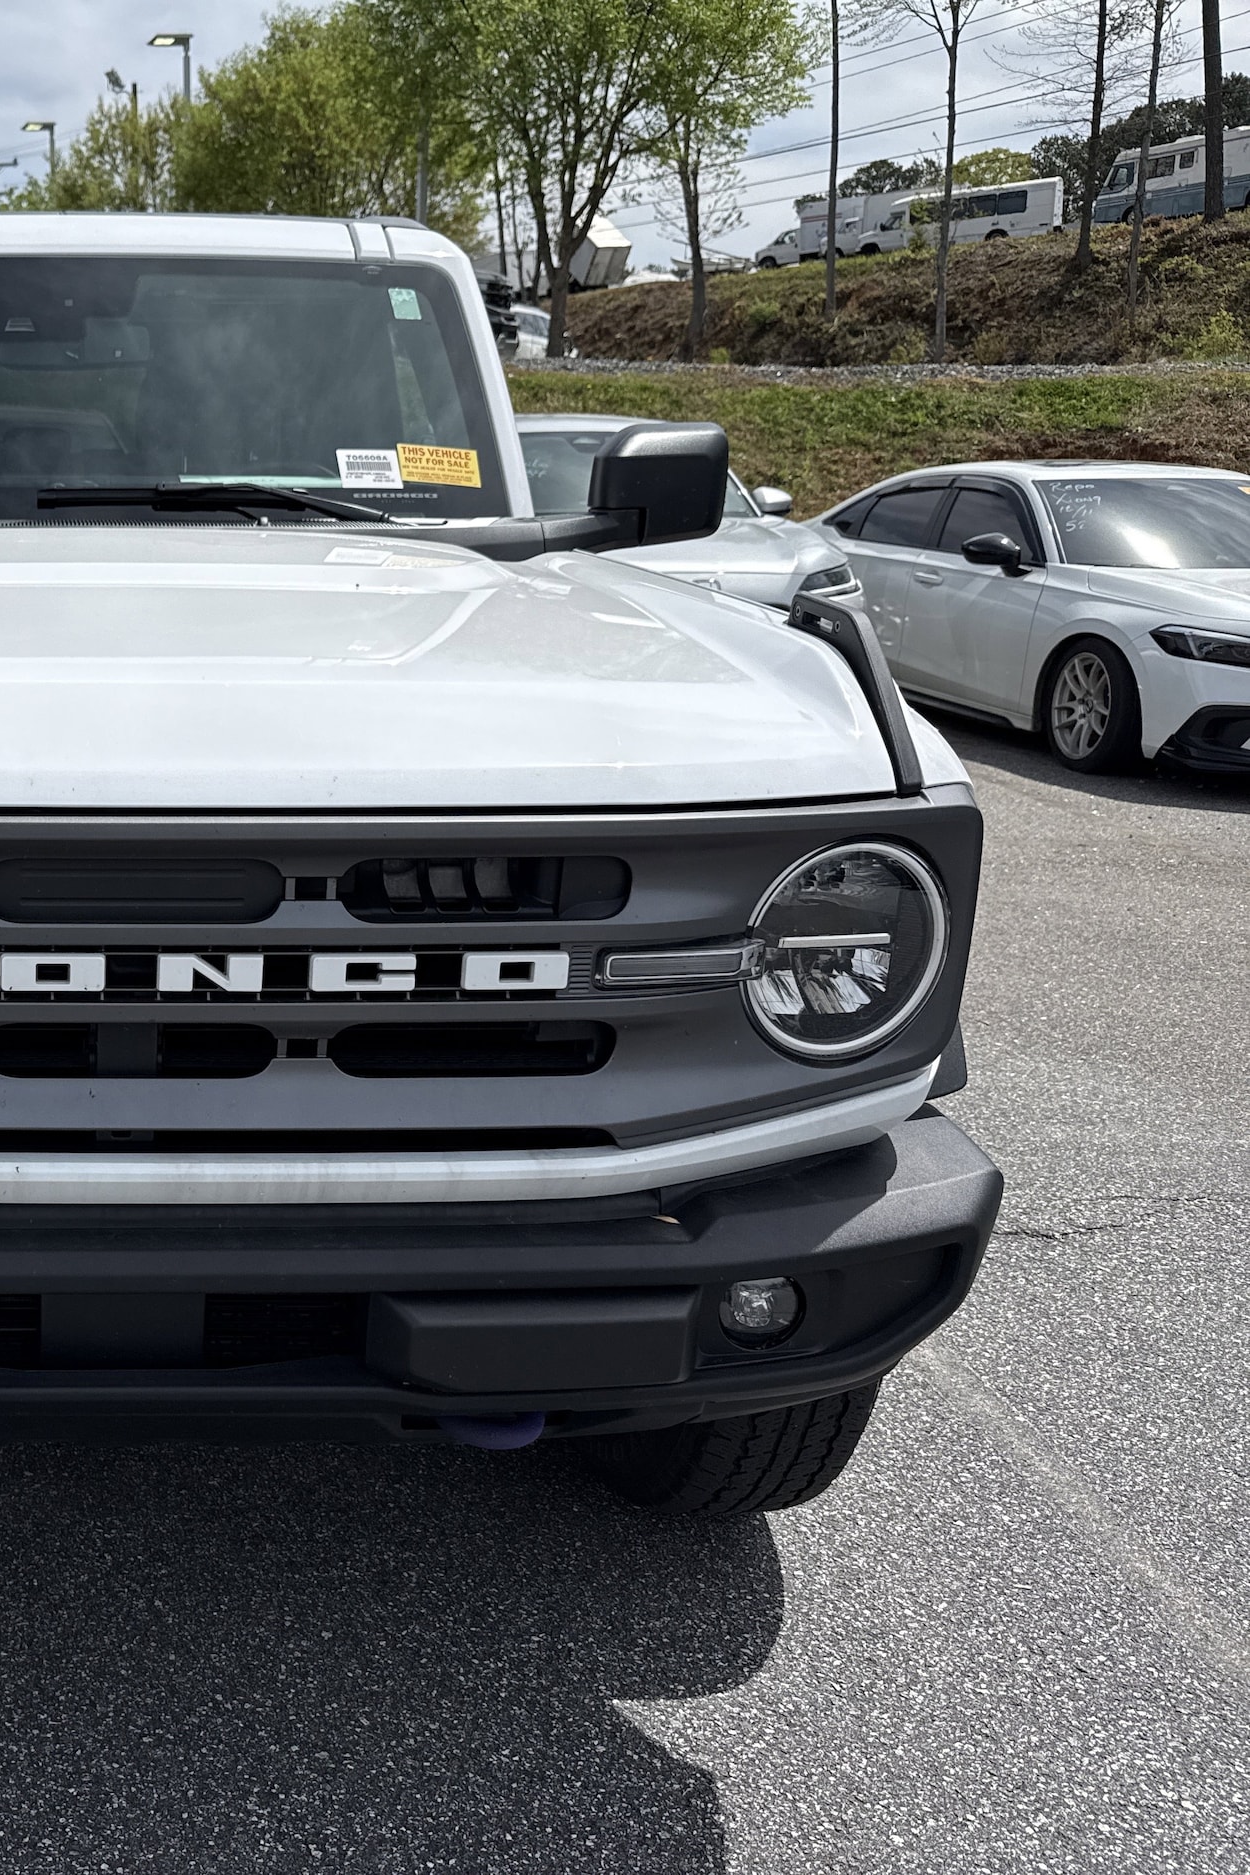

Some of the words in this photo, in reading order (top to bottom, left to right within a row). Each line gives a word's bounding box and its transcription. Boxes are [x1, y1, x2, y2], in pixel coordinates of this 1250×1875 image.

[401, 446, 425, 456] THIS
[427, 448, 471, 461] VEHICLE
[404, 456, 423, 465] NOT
[426, 458, 445, 466] FOR
[447, 459, 470, 469] SALE
